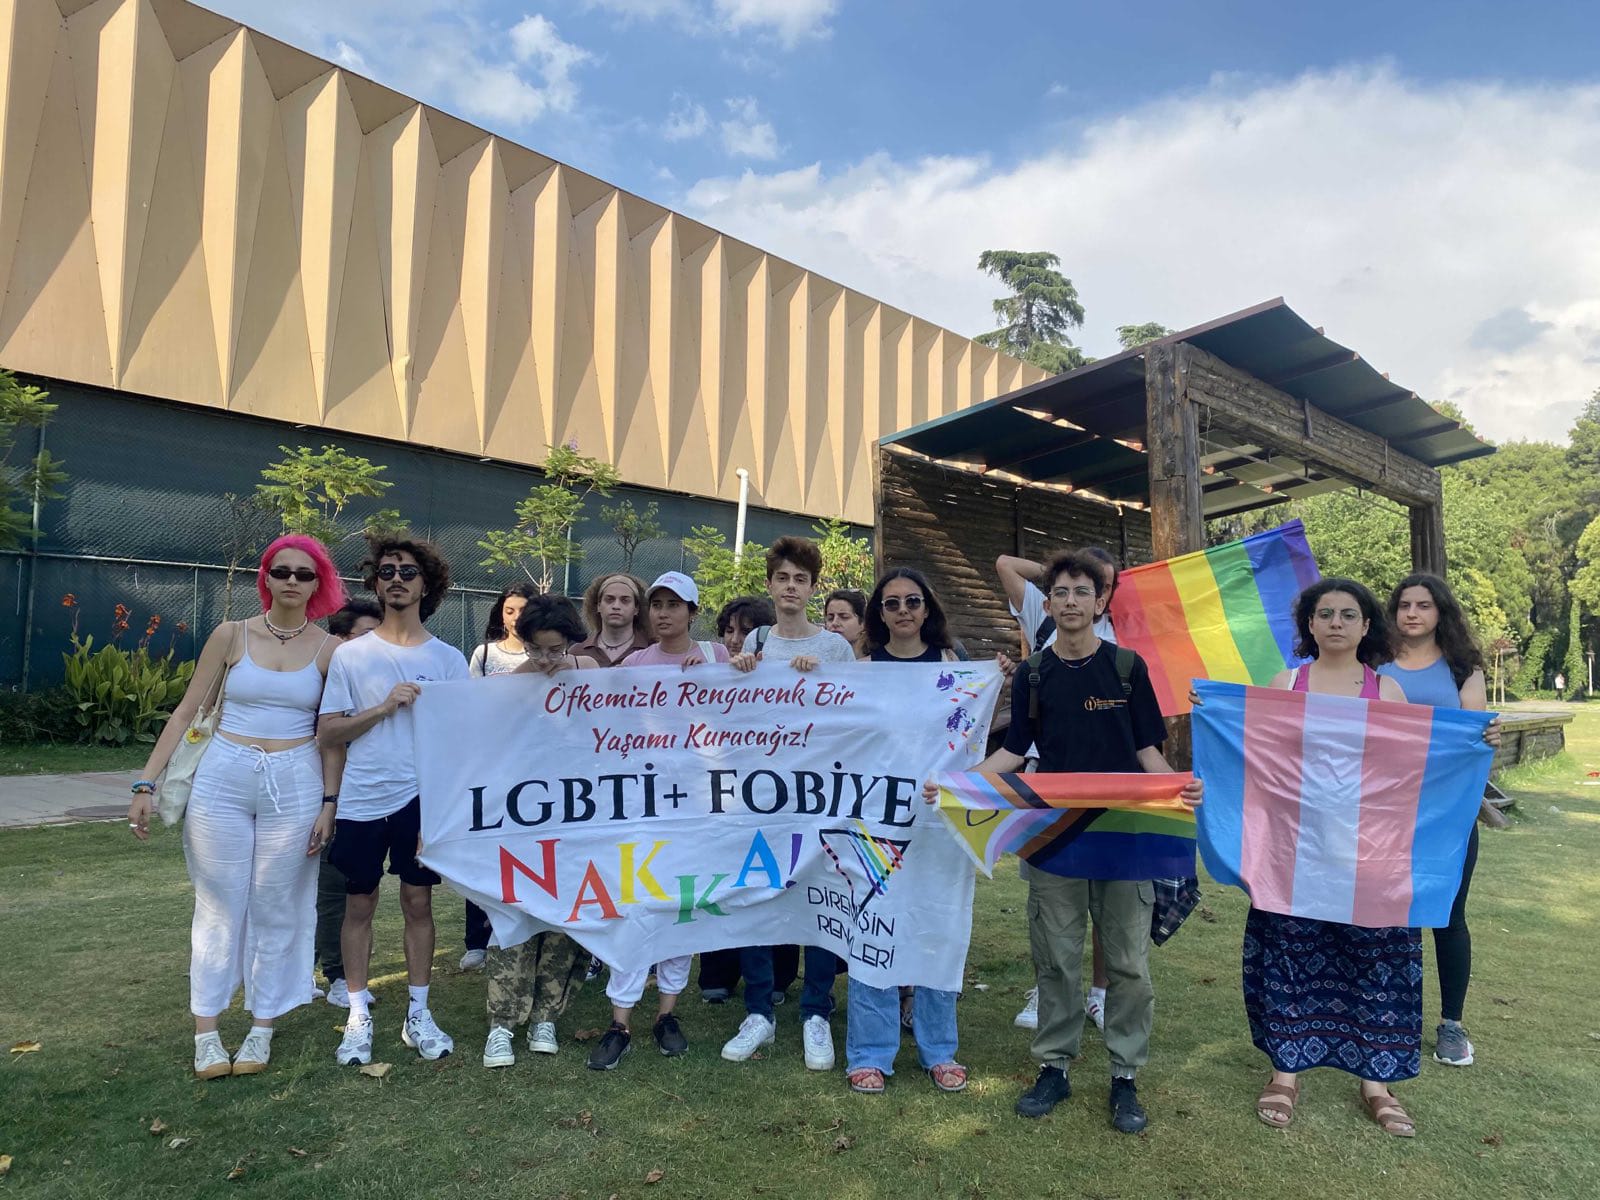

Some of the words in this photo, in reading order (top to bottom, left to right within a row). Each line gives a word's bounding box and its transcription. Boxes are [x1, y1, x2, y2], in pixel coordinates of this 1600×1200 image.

[544, 681, 667, 717] Öfkemizle
[677, 678, 806, 714] Rengarenk
[814, 682, 855, 706] Bir
[592, 727, 678, 759] Yaşamı
[683, 723, 814, 756] Kuracağız!
[468, 763, 688, 832] LGBTİ+
[709, 761, 917, 828] FOBİYE
[499, 828, 803, 925] NAKKA!
